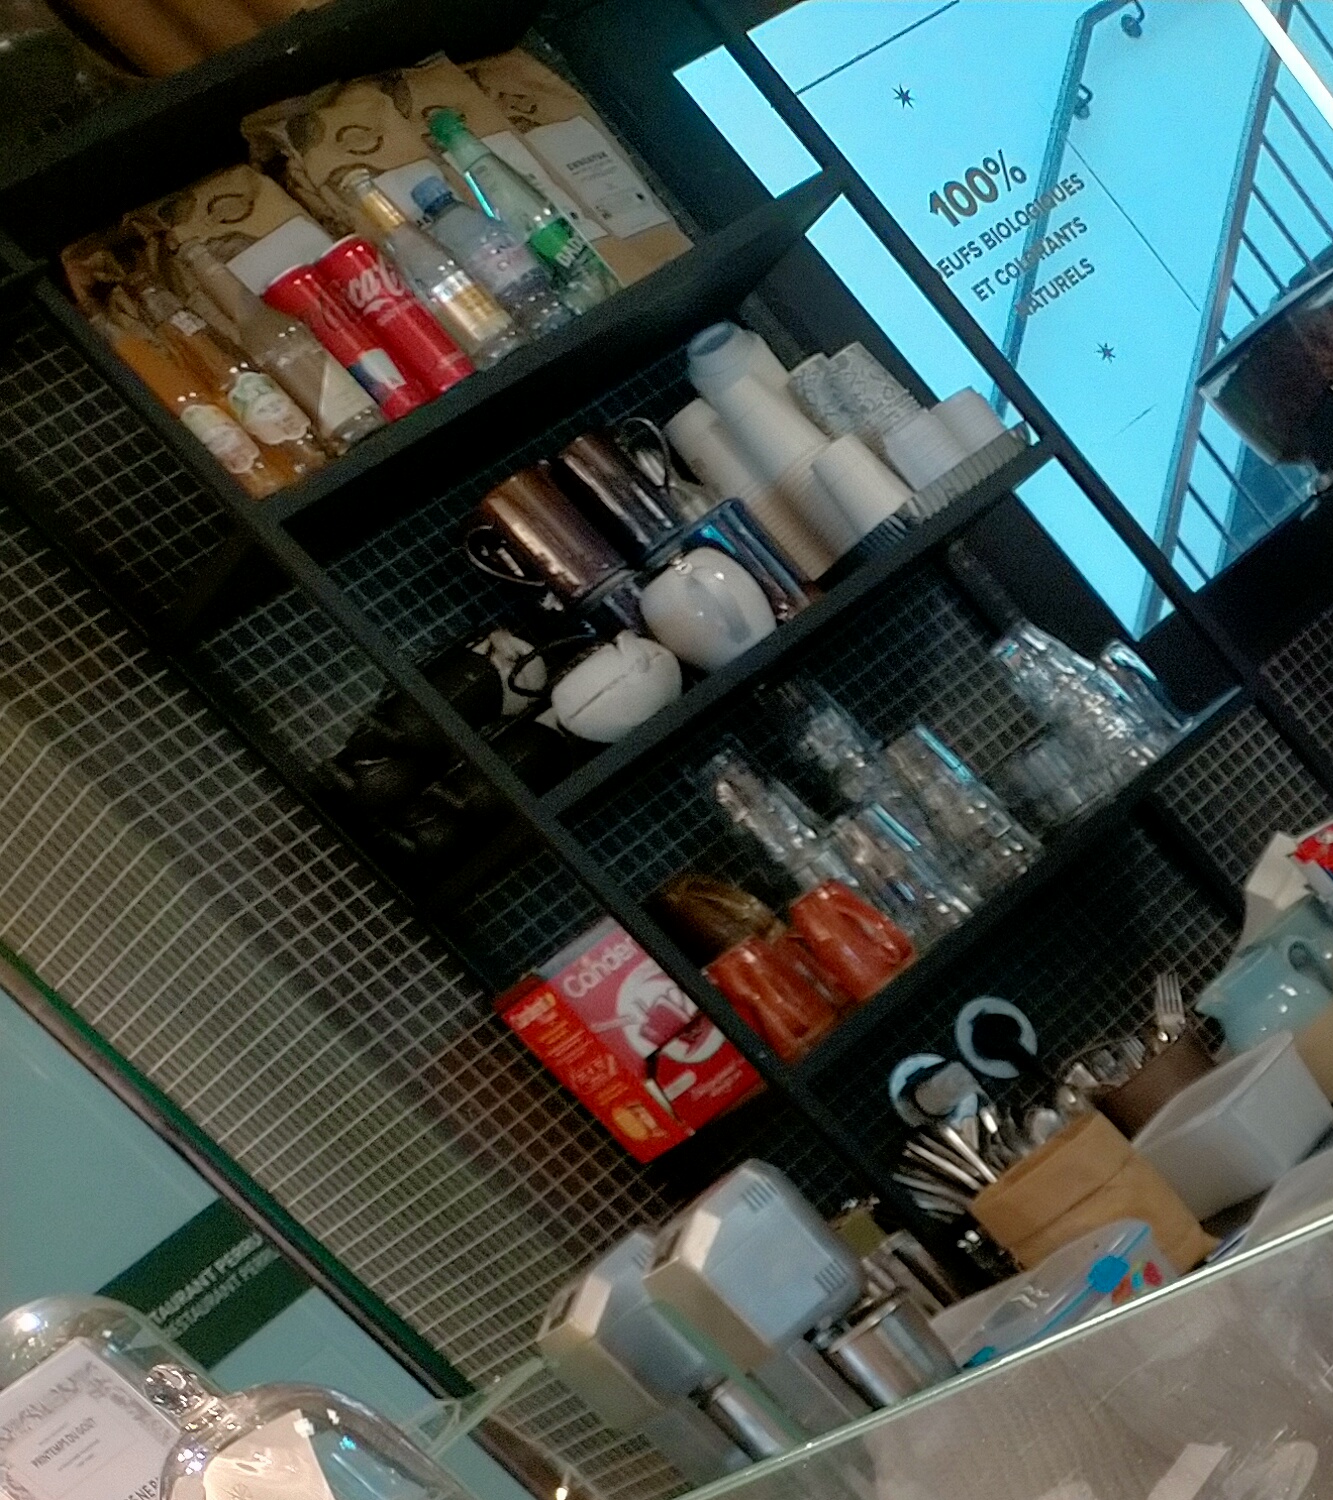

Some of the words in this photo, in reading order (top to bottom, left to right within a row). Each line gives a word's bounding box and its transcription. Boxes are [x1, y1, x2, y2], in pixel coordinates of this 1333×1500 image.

[929, 149, 1027, 227] 100%
[978, 173, 1085, 251] BIOLOGIQUES
[971, 277, 996, 301] ET
